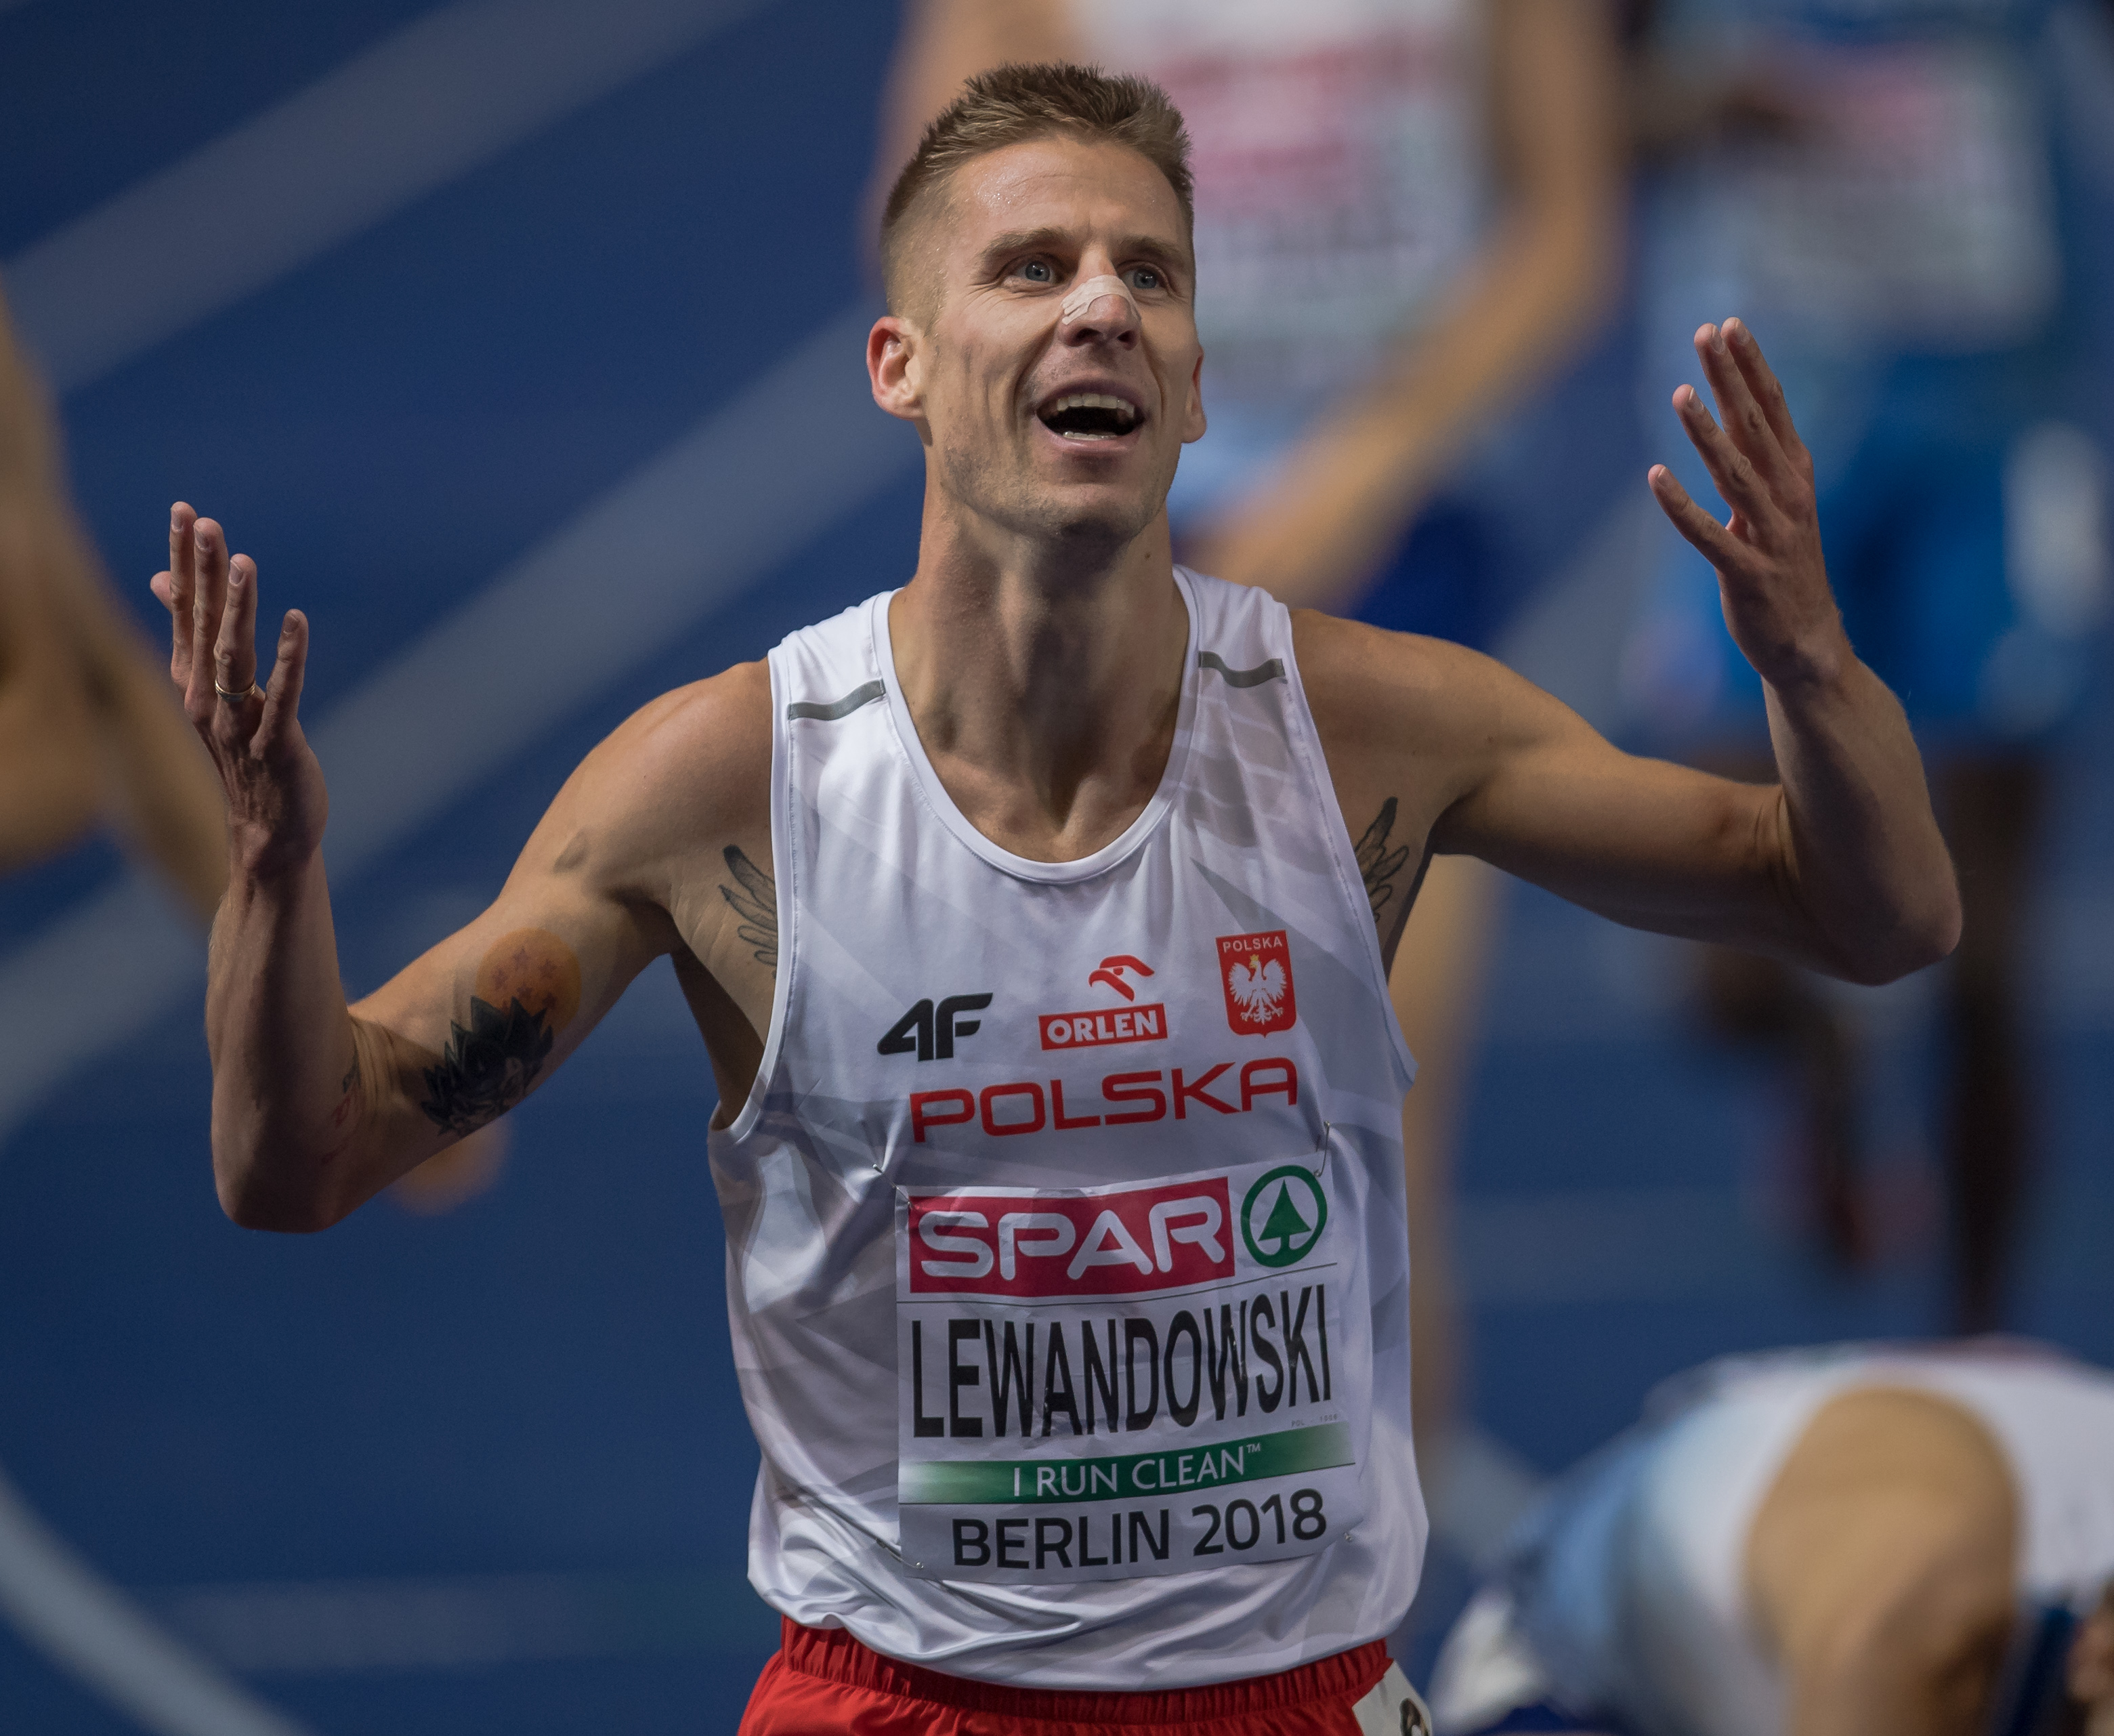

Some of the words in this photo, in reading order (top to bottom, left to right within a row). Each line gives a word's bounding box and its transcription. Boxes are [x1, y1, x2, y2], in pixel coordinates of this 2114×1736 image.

[1223, 935, 1283, 953] POLSKA
[877, 992, 993, 1061] 4F
[1047, 1009, 1158, 1043] ORLEN
[910, 1057, 1298, 1143] POLSKA
[918, 1195, 1225, 1280] SPAR
[912, 1284, 1332, 1438] LEWANDOWSKI
[1014, 1468, 1019, 1497] I
[1036, 1465, 1118, 1497] RUN
[952, 1509, 1170, 1569] BERLIN
[1191, 1488, 1326, 1557] 2018
